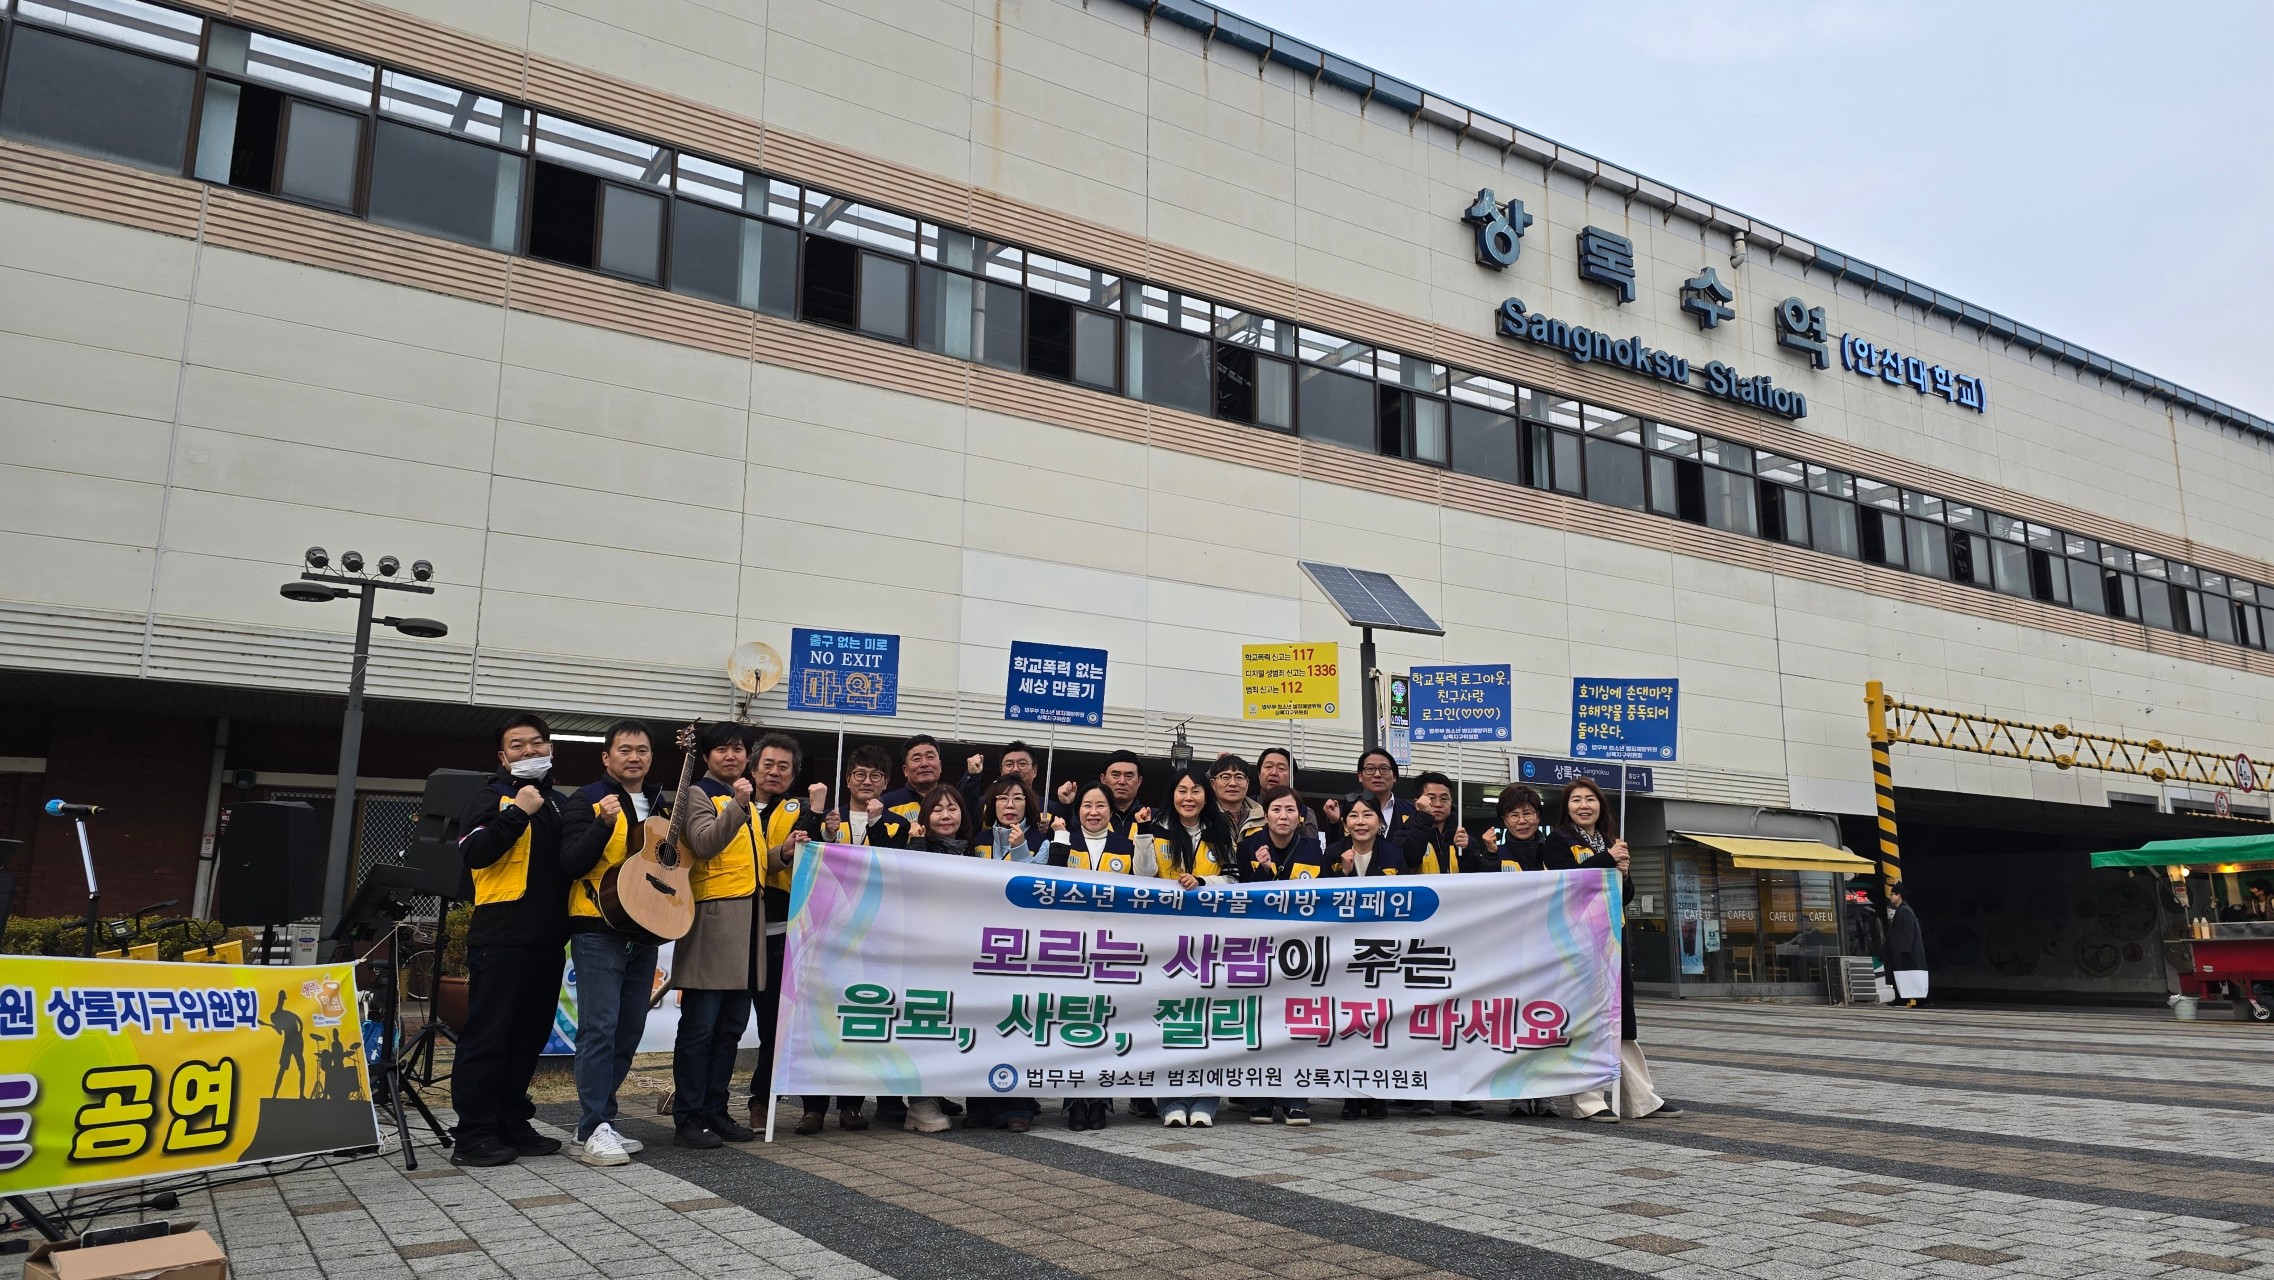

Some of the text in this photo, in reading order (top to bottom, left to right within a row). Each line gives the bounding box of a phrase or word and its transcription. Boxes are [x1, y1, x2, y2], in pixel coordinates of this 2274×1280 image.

[1498, 297, 1808, 418] Sangnoksu Station
[1840, 333, 1987, 414] (안산대학교)
[809, 634, 888, 651] 출구 없는 미로
[809, 650, 883, 668] NO EXIT
[1245, 648, 1314, 662] 학교폭력 신고는 117
[1013, 656, 1104, 680] 학교폭력 없는
[1245, 664, 1336, 678] 디지털 성범죄 신고는 1336
[1412, 670, 1510, 686] 학교폭력 로그아웃,
[1018, 677, 1095, 700] 세상 만들기
[1246, 681, 1302, 695] 범죄 신고는 112
[1438, 689, 1485, 703] 친구사랑
[1579, 684, 1674, 701] 호기심에 손댄마약
[1578, 704, 1669, 722] 유해약물 중독되어
[1578, 722, 1624, 740] 돌아온다.
[1554, 765, 1582, 780] 상록수
[1583, 766, 1610, 776] Sangnoksu
[1641, 772, 1648, 787] 1
[1031, 879, 1414, 918] 청소년 유해 약물 예방 캠페인
[1684, 909, 1711, 920] CAFE U
[1727, 910, 1754, 921] CAFE U
[1769, 911, 1794, 922] CAFE U
[1809, 911, 1833, 922] CAFE U
[971, 926, 1455, 987] 모르는 사람이 주는
[47, 988, 259, 1037] 상록지구위원회
[836, 983, 1573, 1055] 음료, 사탕, 젤리 먹지 마세요
[1027, 1068, 1428, 1090] 법무부 청소년 범죄예방위원 상록지구위원회
[68, 1057, 236, 1162] 공연
